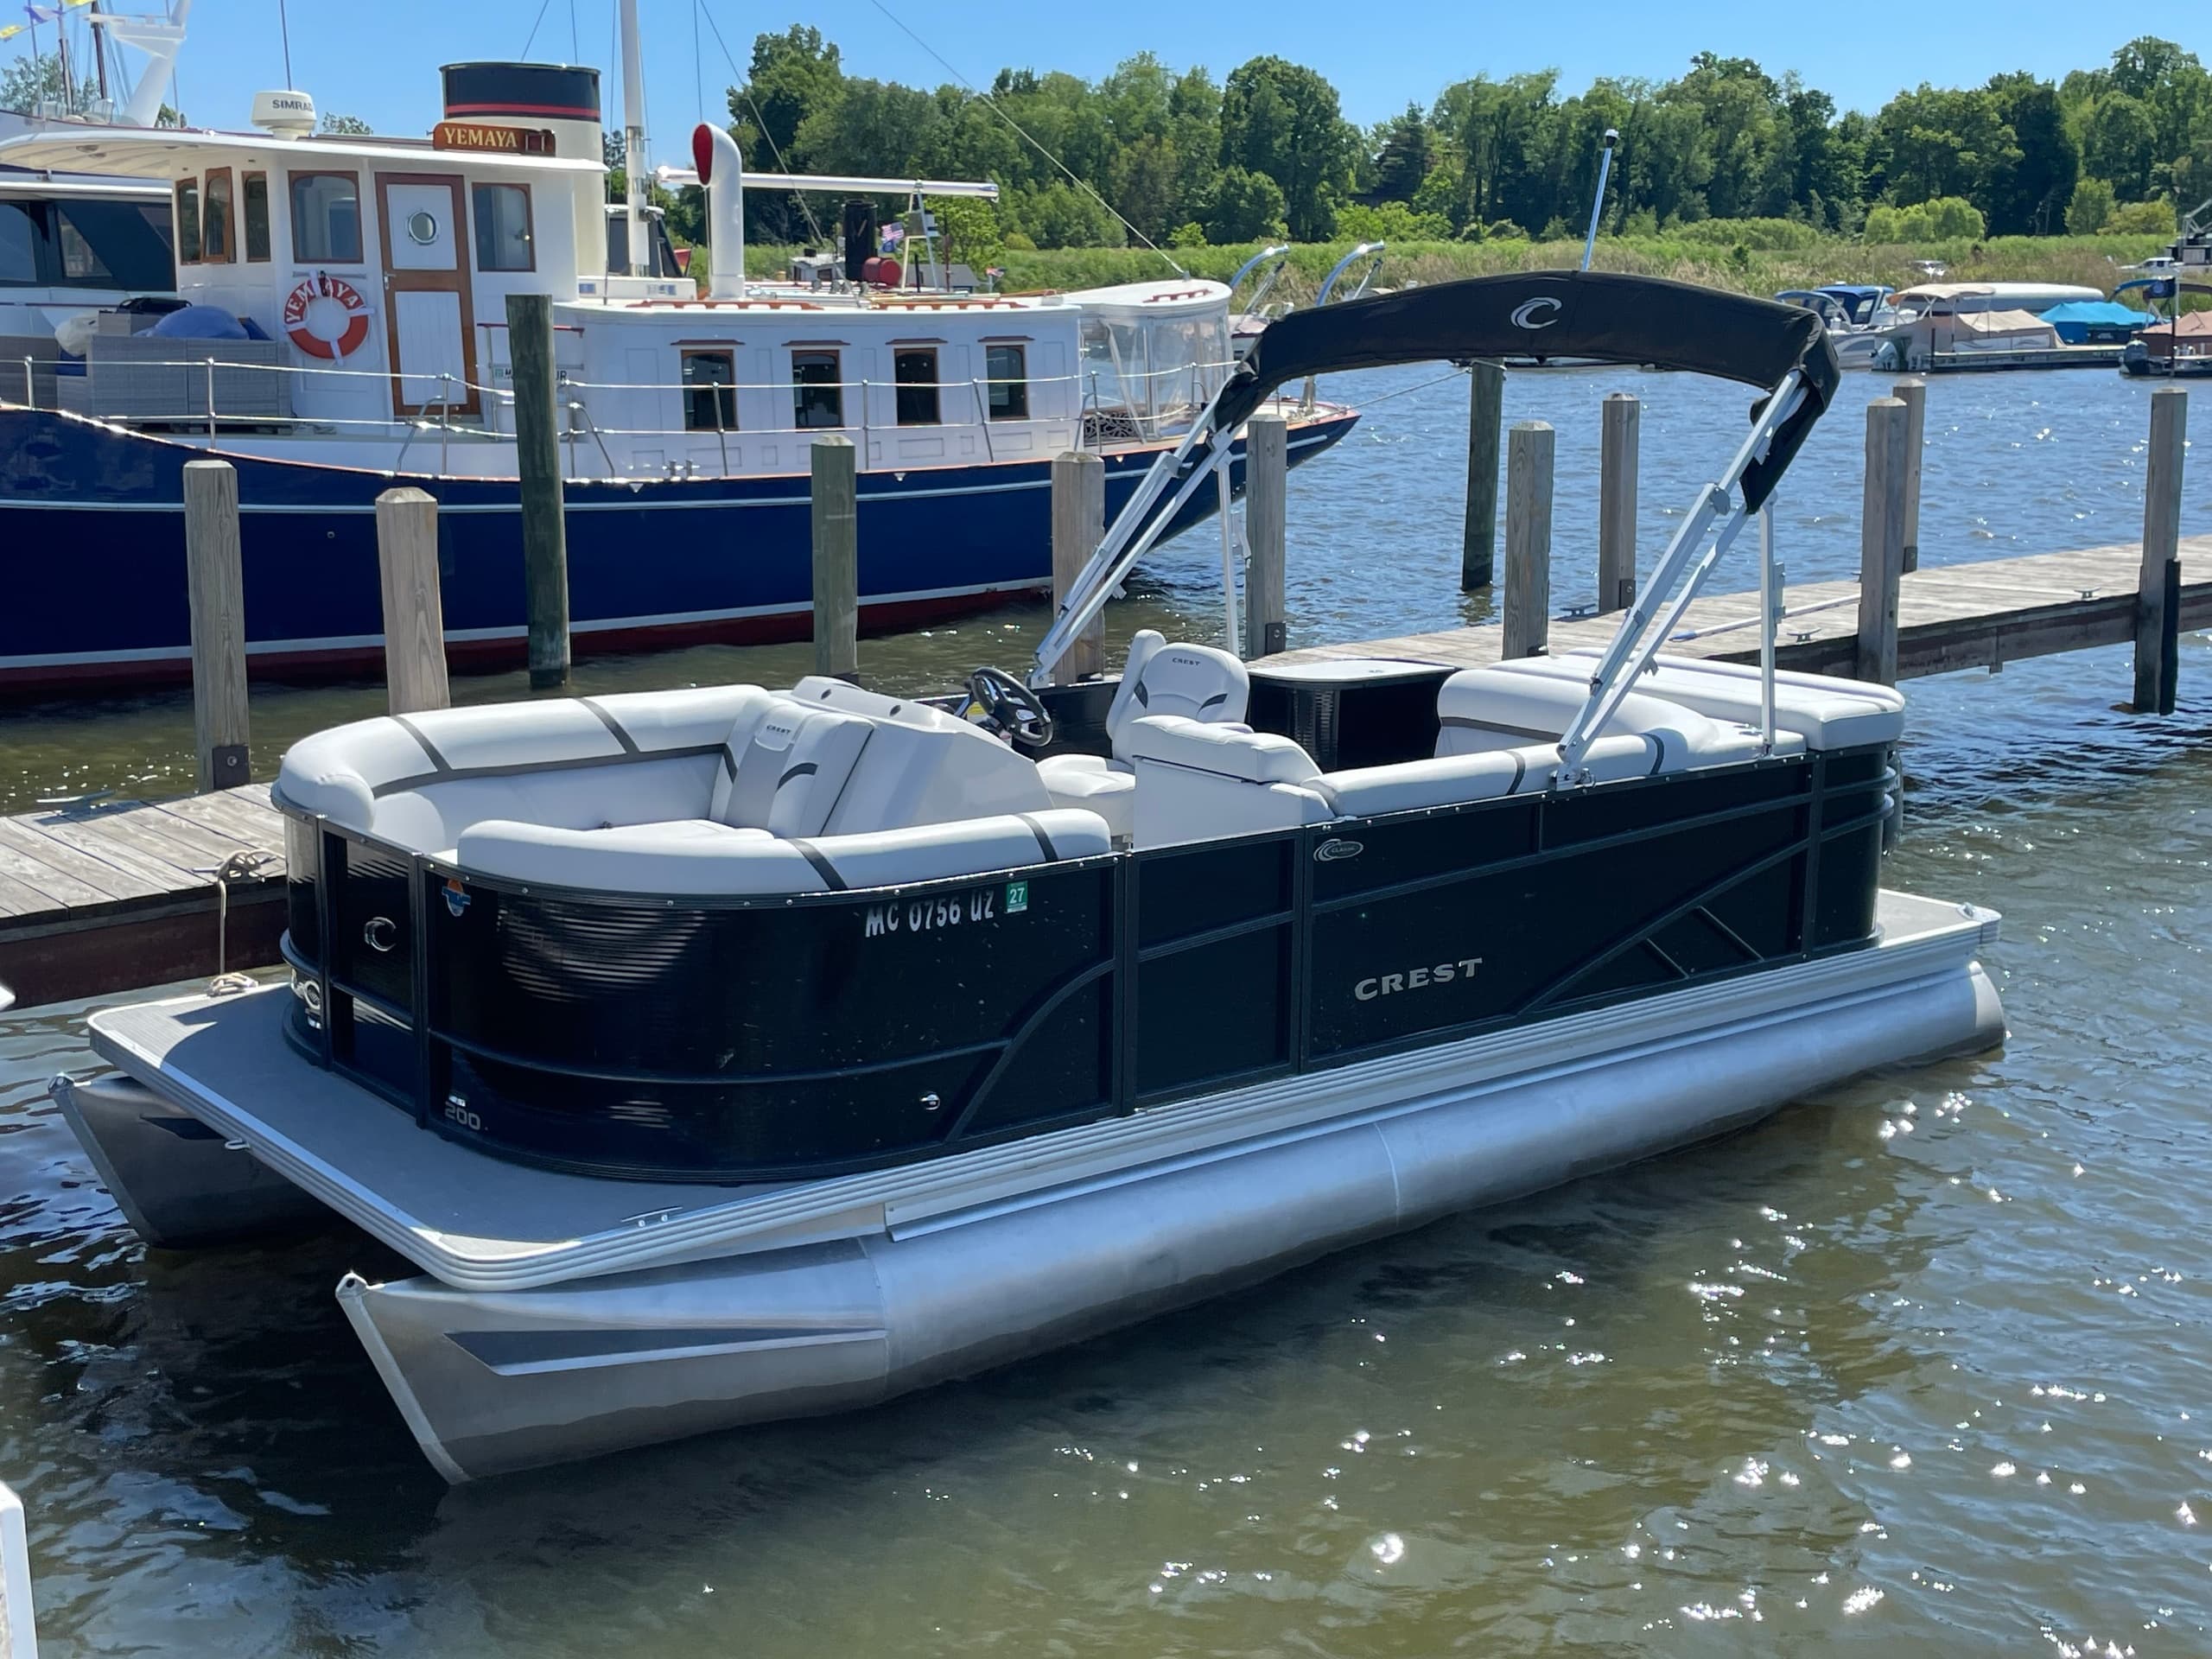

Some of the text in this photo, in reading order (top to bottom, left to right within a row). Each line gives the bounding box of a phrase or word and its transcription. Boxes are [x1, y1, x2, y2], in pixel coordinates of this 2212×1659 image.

[443, 127, 518, 148] YEMAYA
[1172, 657, 1200, 666] CREST
[1009, 887, 1025, 904] 27
[865, 888, 994, 938] MC 0756 UZ
[1354, 957, 1483, 1001] CREST
[445, 1101, 481, 1130] 200
